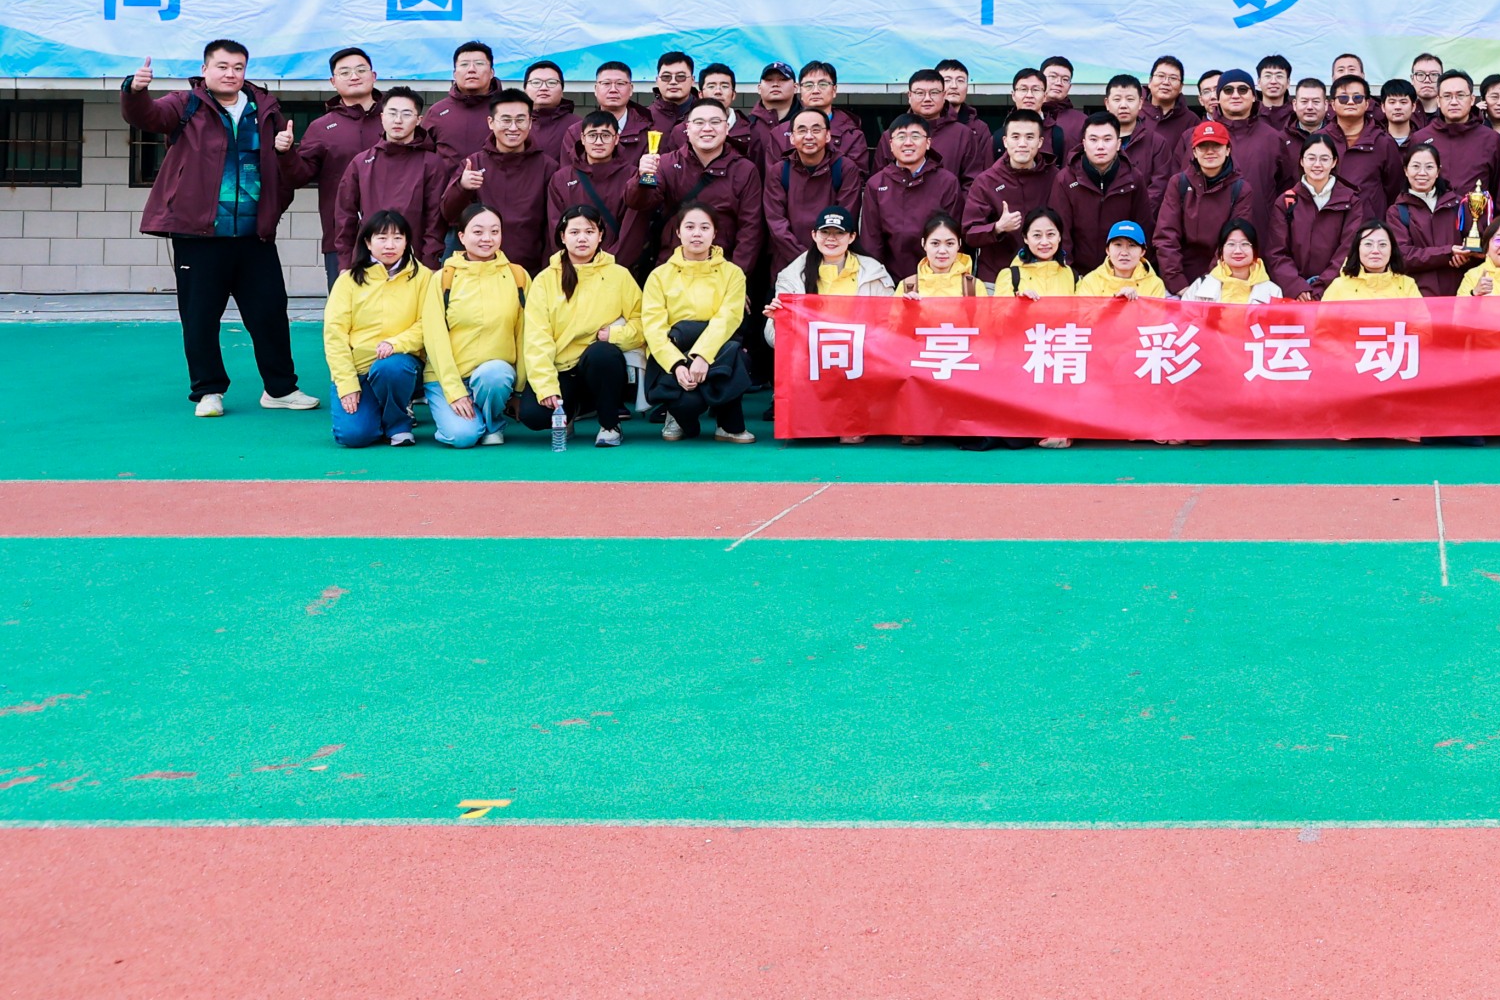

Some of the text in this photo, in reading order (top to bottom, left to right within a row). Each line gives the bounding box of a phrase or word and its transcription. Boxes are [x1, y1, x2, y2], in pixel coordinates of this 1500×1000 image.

[807, 321, 1420, 386] 同享精彩运动
